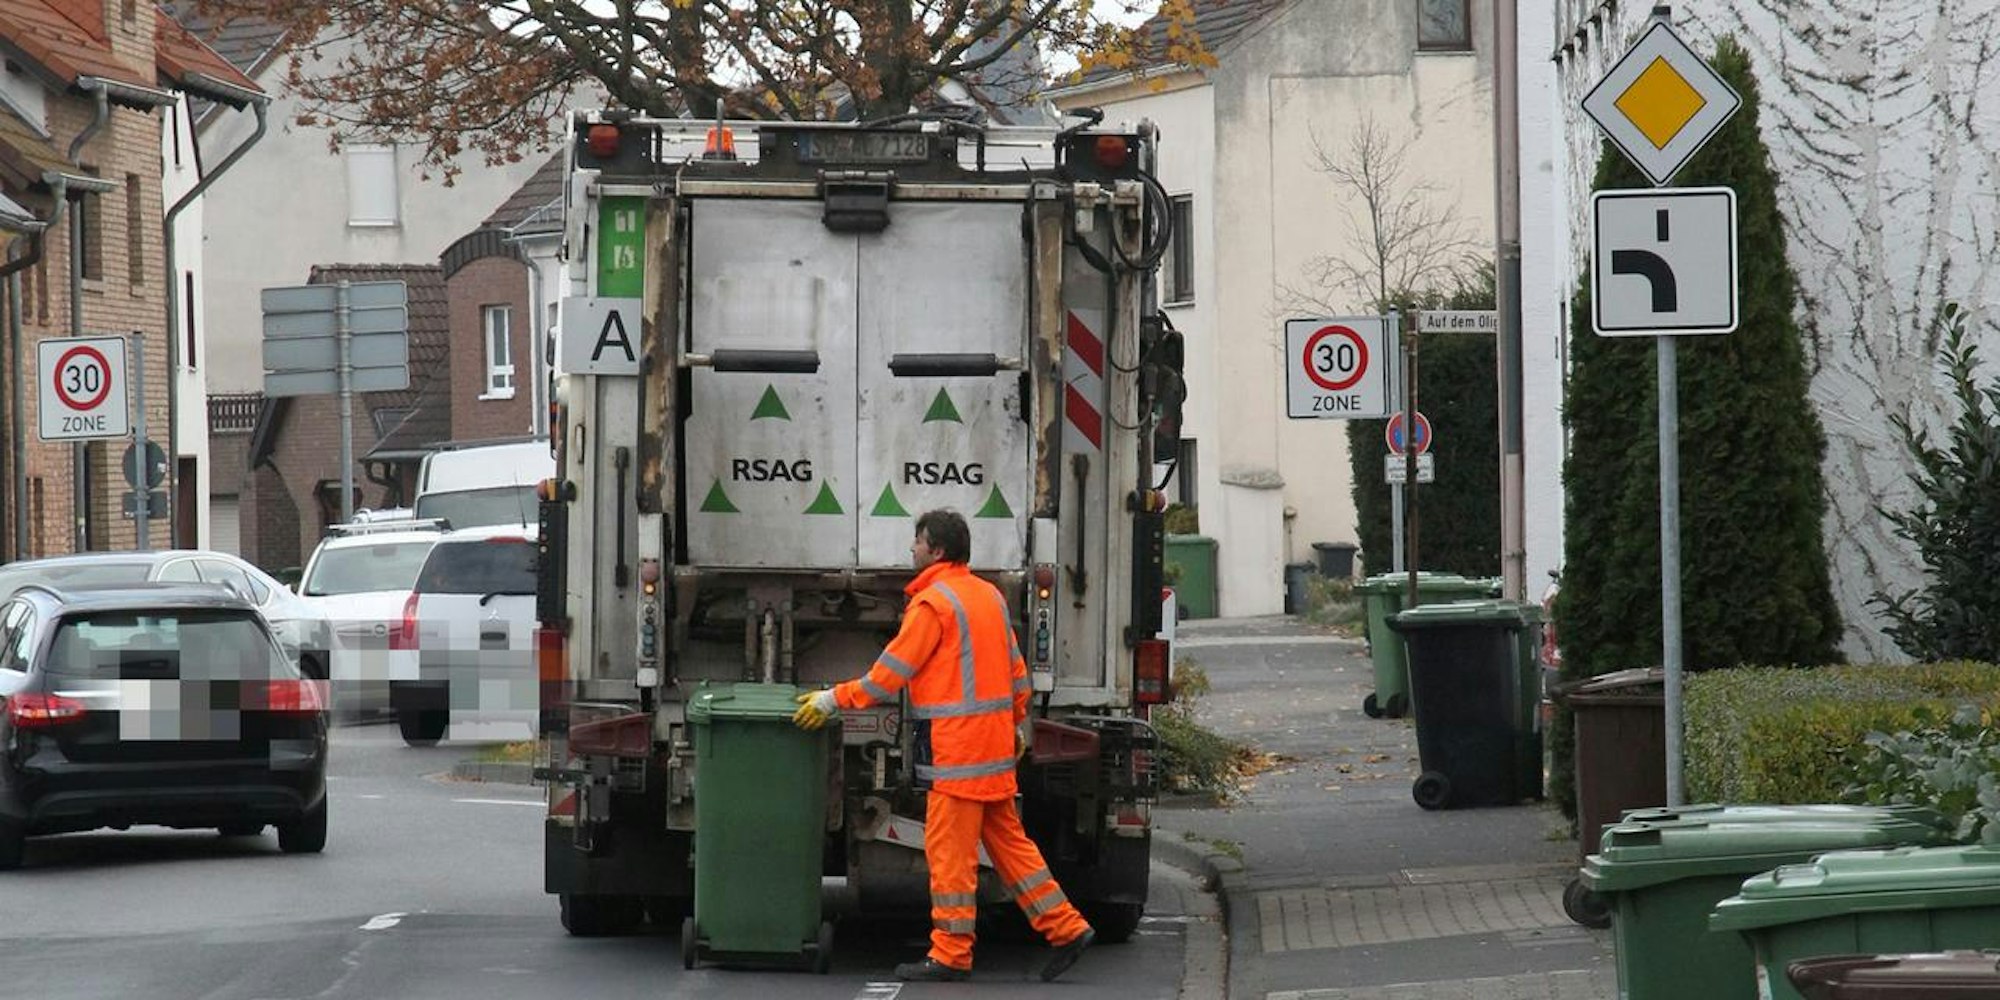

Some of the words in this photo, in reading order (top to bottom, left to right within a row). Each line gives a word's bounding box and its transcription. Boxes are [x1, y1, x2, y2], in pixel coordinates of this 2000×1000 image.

[881, 136, 925, 156] 7128
[1427, 315, 1446, 328] Auf
[1451, 315, 1475, 328] dem
[591, 309, 636, 362] A
[1317, 344, 1354, 373] 30
[66, 364, 99, 394] 30
[1312, 395, 1362, 412] ZONE
[62, 415, 106, 433] ZONE
[732, 459, 813, 482] RSAG
[904, 462, 984, 485] RSAG
